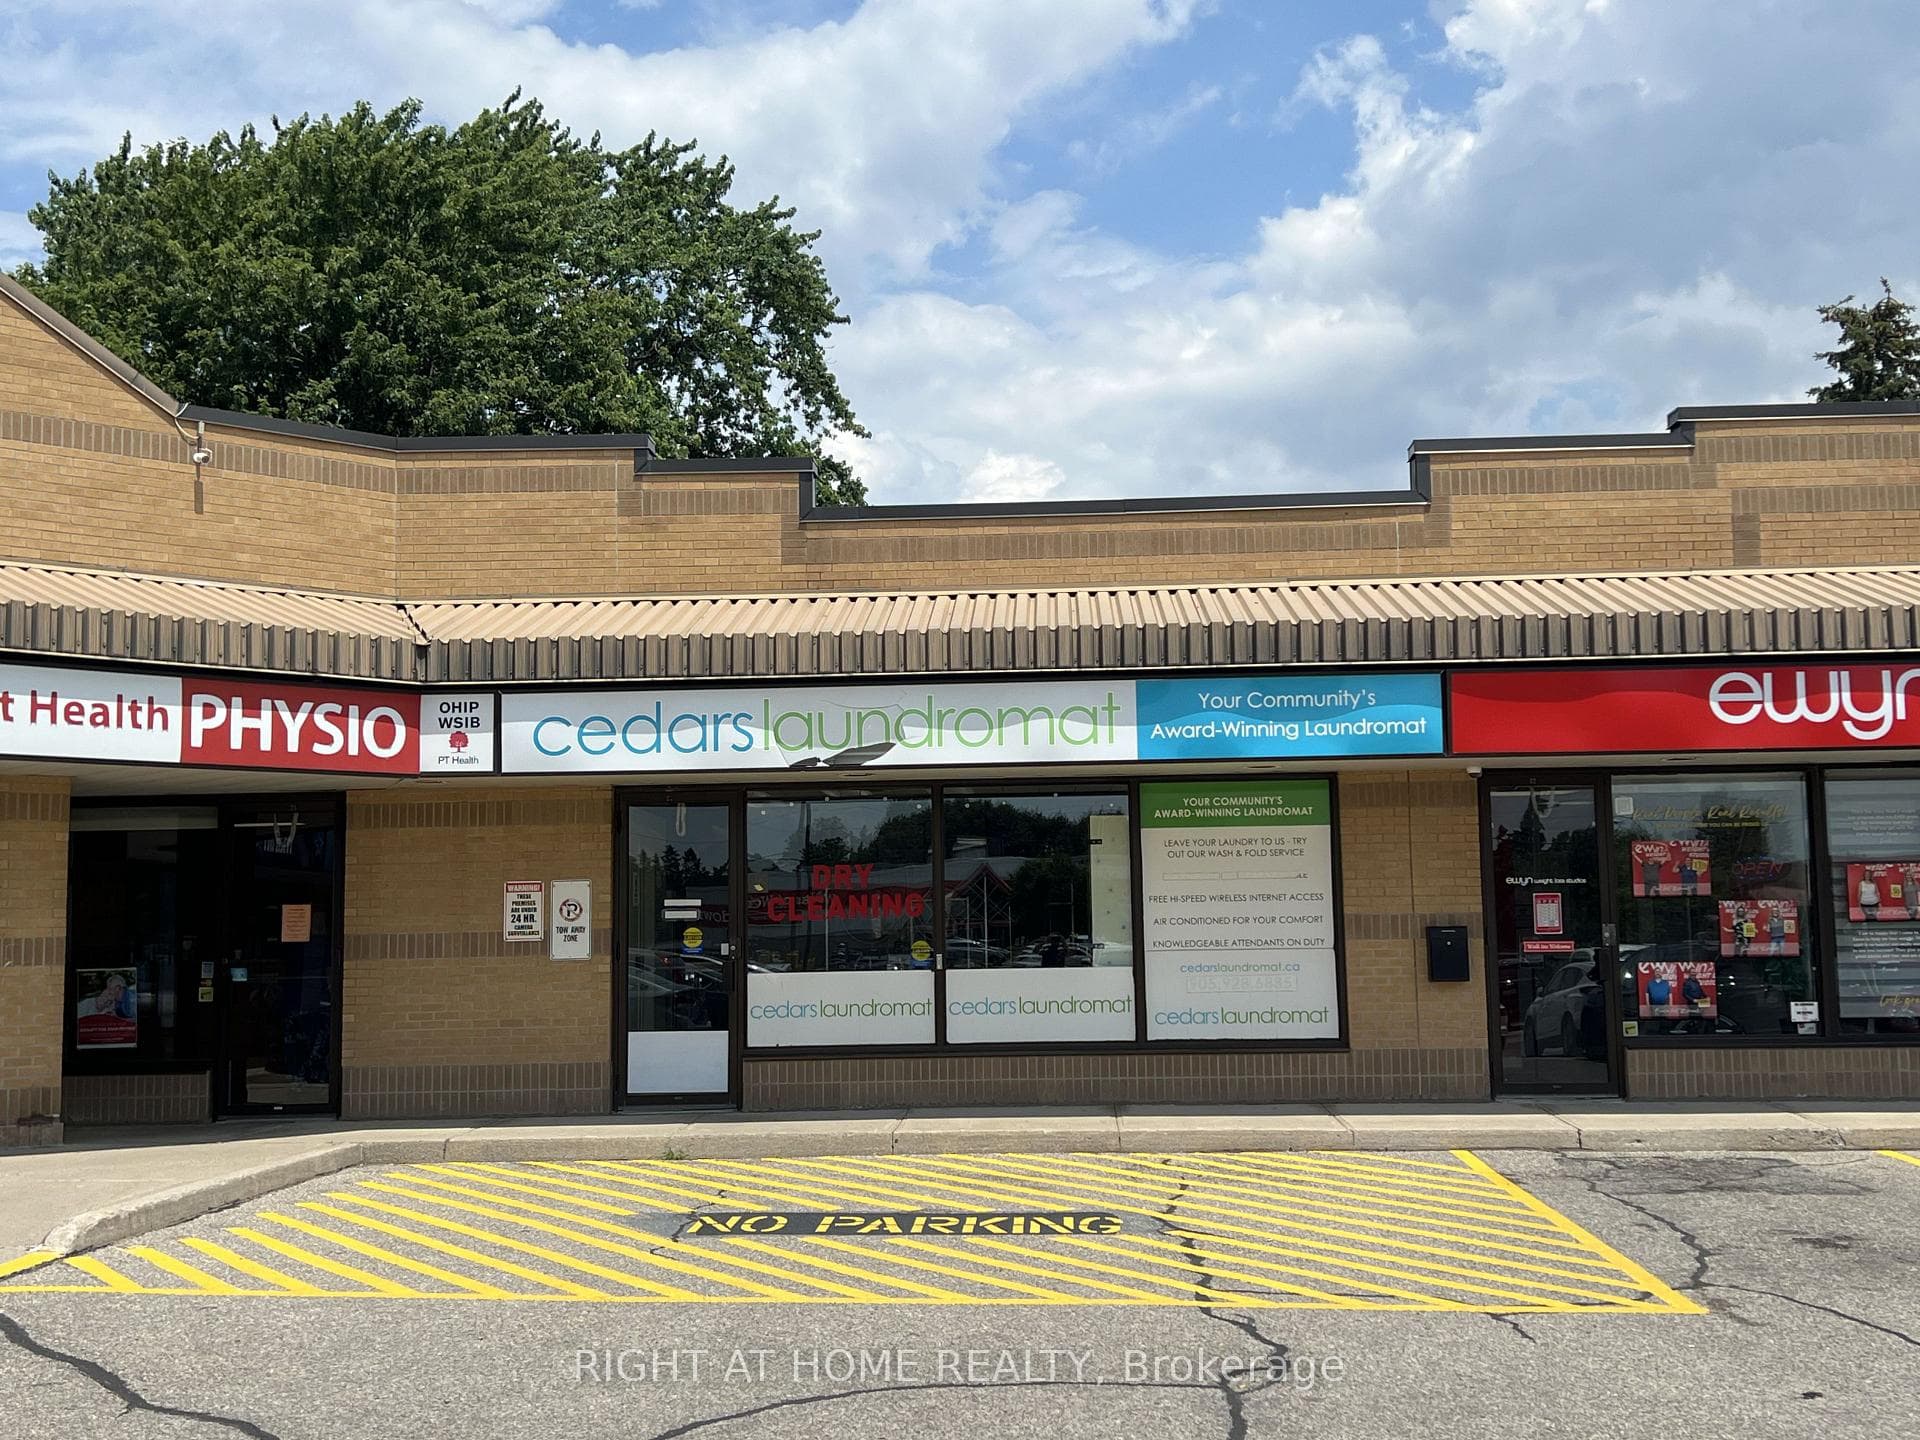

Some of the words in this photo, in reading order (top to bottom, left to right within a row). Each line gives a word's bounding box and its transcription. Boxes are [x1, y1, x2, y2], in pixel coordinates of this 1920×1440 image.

[1198, 692, 1242, 709] Your
[1247, 690, 1376, 710] Community's
[31, 689, 169, 732] Health
[440, 702, 479, 713] OHIP
[190, 693, 407, 758] PHYSIO
[438, 717, 480, 728] WSIB
[1150, 721, 1299, 740] Award-Winning
[1305, 717, 1427, 737] Laundromat
[438, 756, 449, 765] PT
[452, 755, 479, 765] Health
[1183, 797, 1210, 807] YOUR
[1212, 796, 1283, 806] COMMUNITY'S
[1154, 808, 1241, 818] AWARD-WINNING
[1244, 806, 1313, 817] LAUNDROMAT
[1164, 839, 1191, 847] LEAVE
[1193, 838, 1216, 847] YOUR
[1218, 838, 1258, 846] LAUNDRY
[1261, 838, 1272, 846] TO
[1274, 837, 1285, 845] US
[1293, 837, 1308, 845] TRY
[1167, 850, 1184, 858] OUT
[1187, 850, 1206, 858] OUR
[1207, 849, 1233, 858] WASH
[1236, 849, 1243, 857] &
[1245, 849, 1267, 857] FOLD
[1269, 848, 1304, 857] SERVICE
[812, 864, 874, 889] DRY
[1505, 877, 1533, 886] ewyn
[1149, 895, 1168, 903] FREE
[1170, 895, 1207, 903] HI-SPEED
[1209, 894, 1247, 902] WIRELESS
[1249, 893, 1288, 902] INTERNET
[1289, 893, 1324, 901] ACCESS
[767, 893, 926, 922] CLEANING
[511, 914, 521, 923] 24
[1153, 917, 1167, 926] AIR
[1169, 917, 1231, 926] CONDITIONED
[1233, 916, 1250, 925] FOR
[1253, 916, 1276, 925] YOUR
[1279, 915, 1323, 924] COMFORT
[556, 926, 568, 934] TOW
[1152, 939, 1229, 948] KNOWLEDGEABLE
[1231, 938, 1284, 947] ATTENDANTS
[1286, 938, 1302, 947] ON
[1304, 938, 1325, 947] DUTY
[687, 1215, 787, 1234] NO
[814, 1215, 1123, 1234] PARKING
